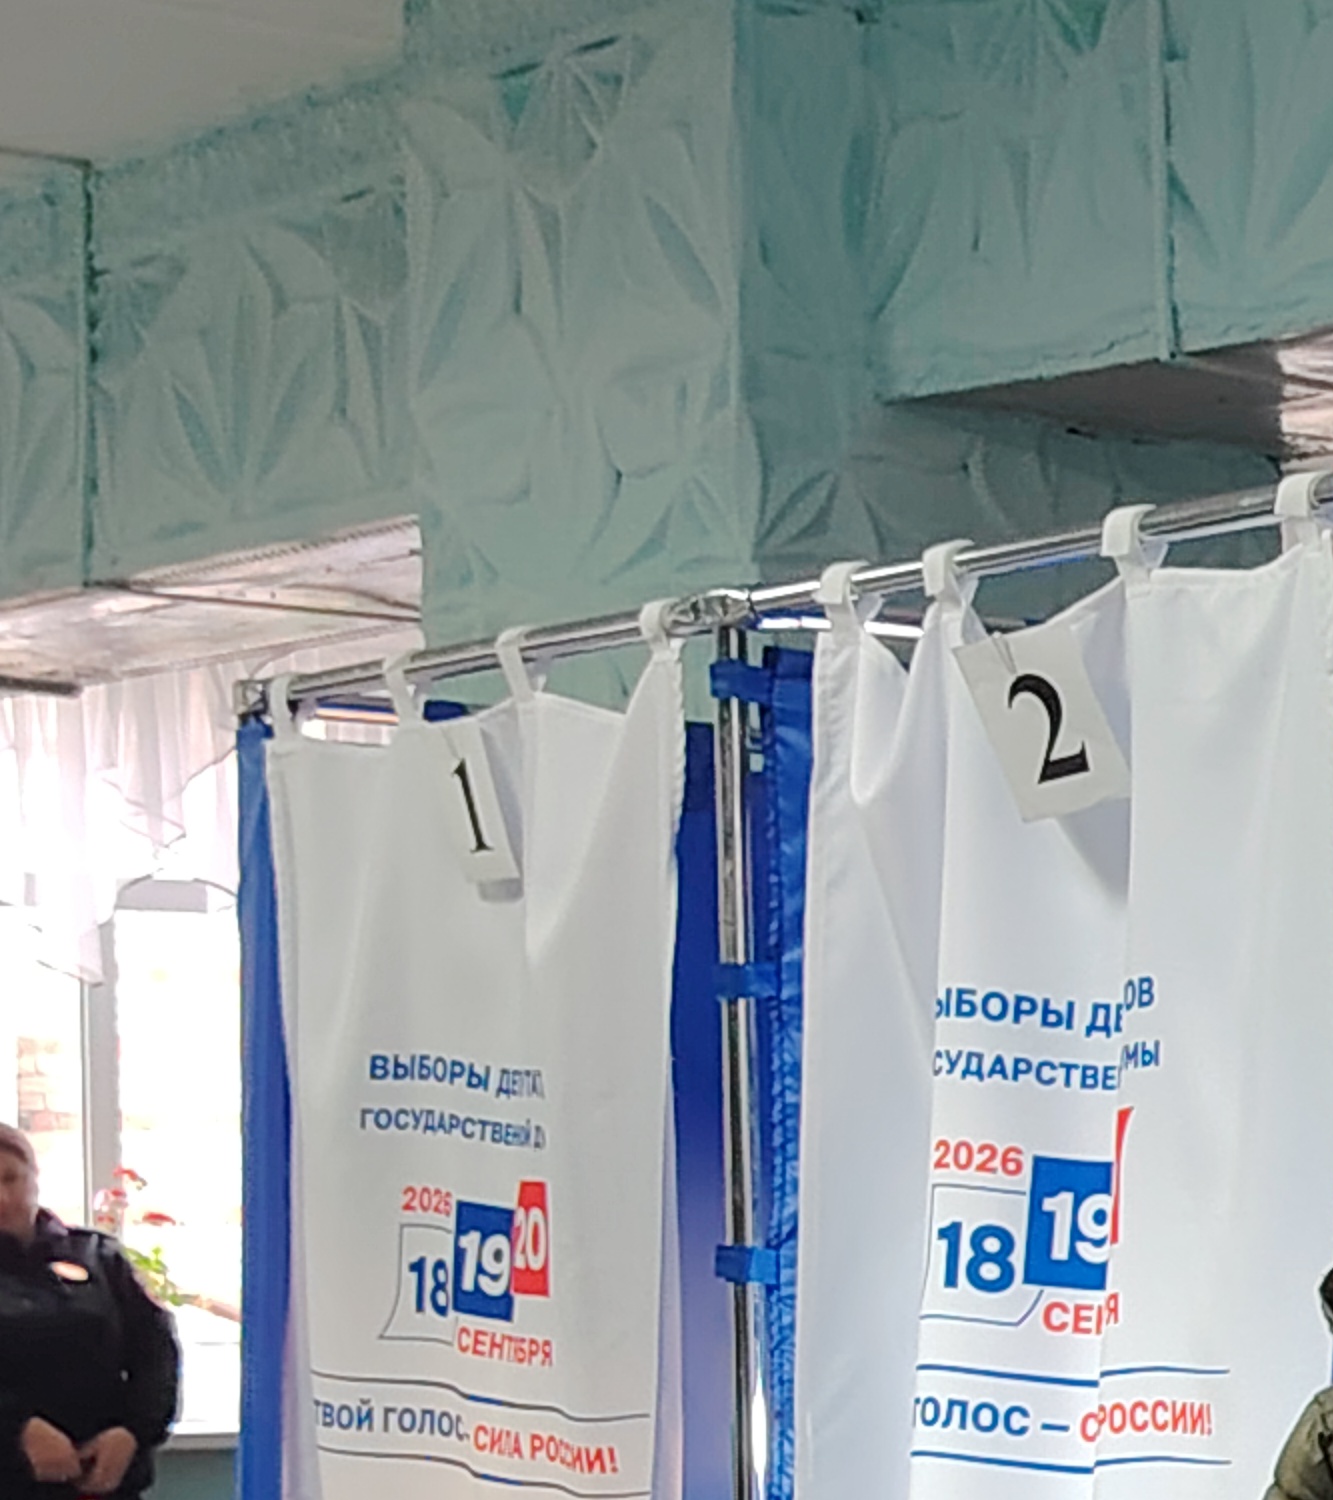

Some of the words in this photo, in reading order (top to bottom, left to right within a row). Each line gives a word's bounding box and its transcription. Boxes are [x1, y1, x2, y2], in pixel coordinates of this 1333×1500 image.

[1007, 673, 1090, 785] 2
[451, 758, 495, 854] 1
[935, 987, 1075, 1032] ЫБОРЫ
[368, 1054, 491, 1092] ВЫБОРЫ
[933, 1139, 1024, 1176] 2026
[409, 1256, 450, 1318] 18
[460, 1230, 511, 1297] 19
[514, 1207, 547, 1271] 20
[937, 1221, 1015, 1293] 18
[1041, 1190, 1111, 1264] 19
